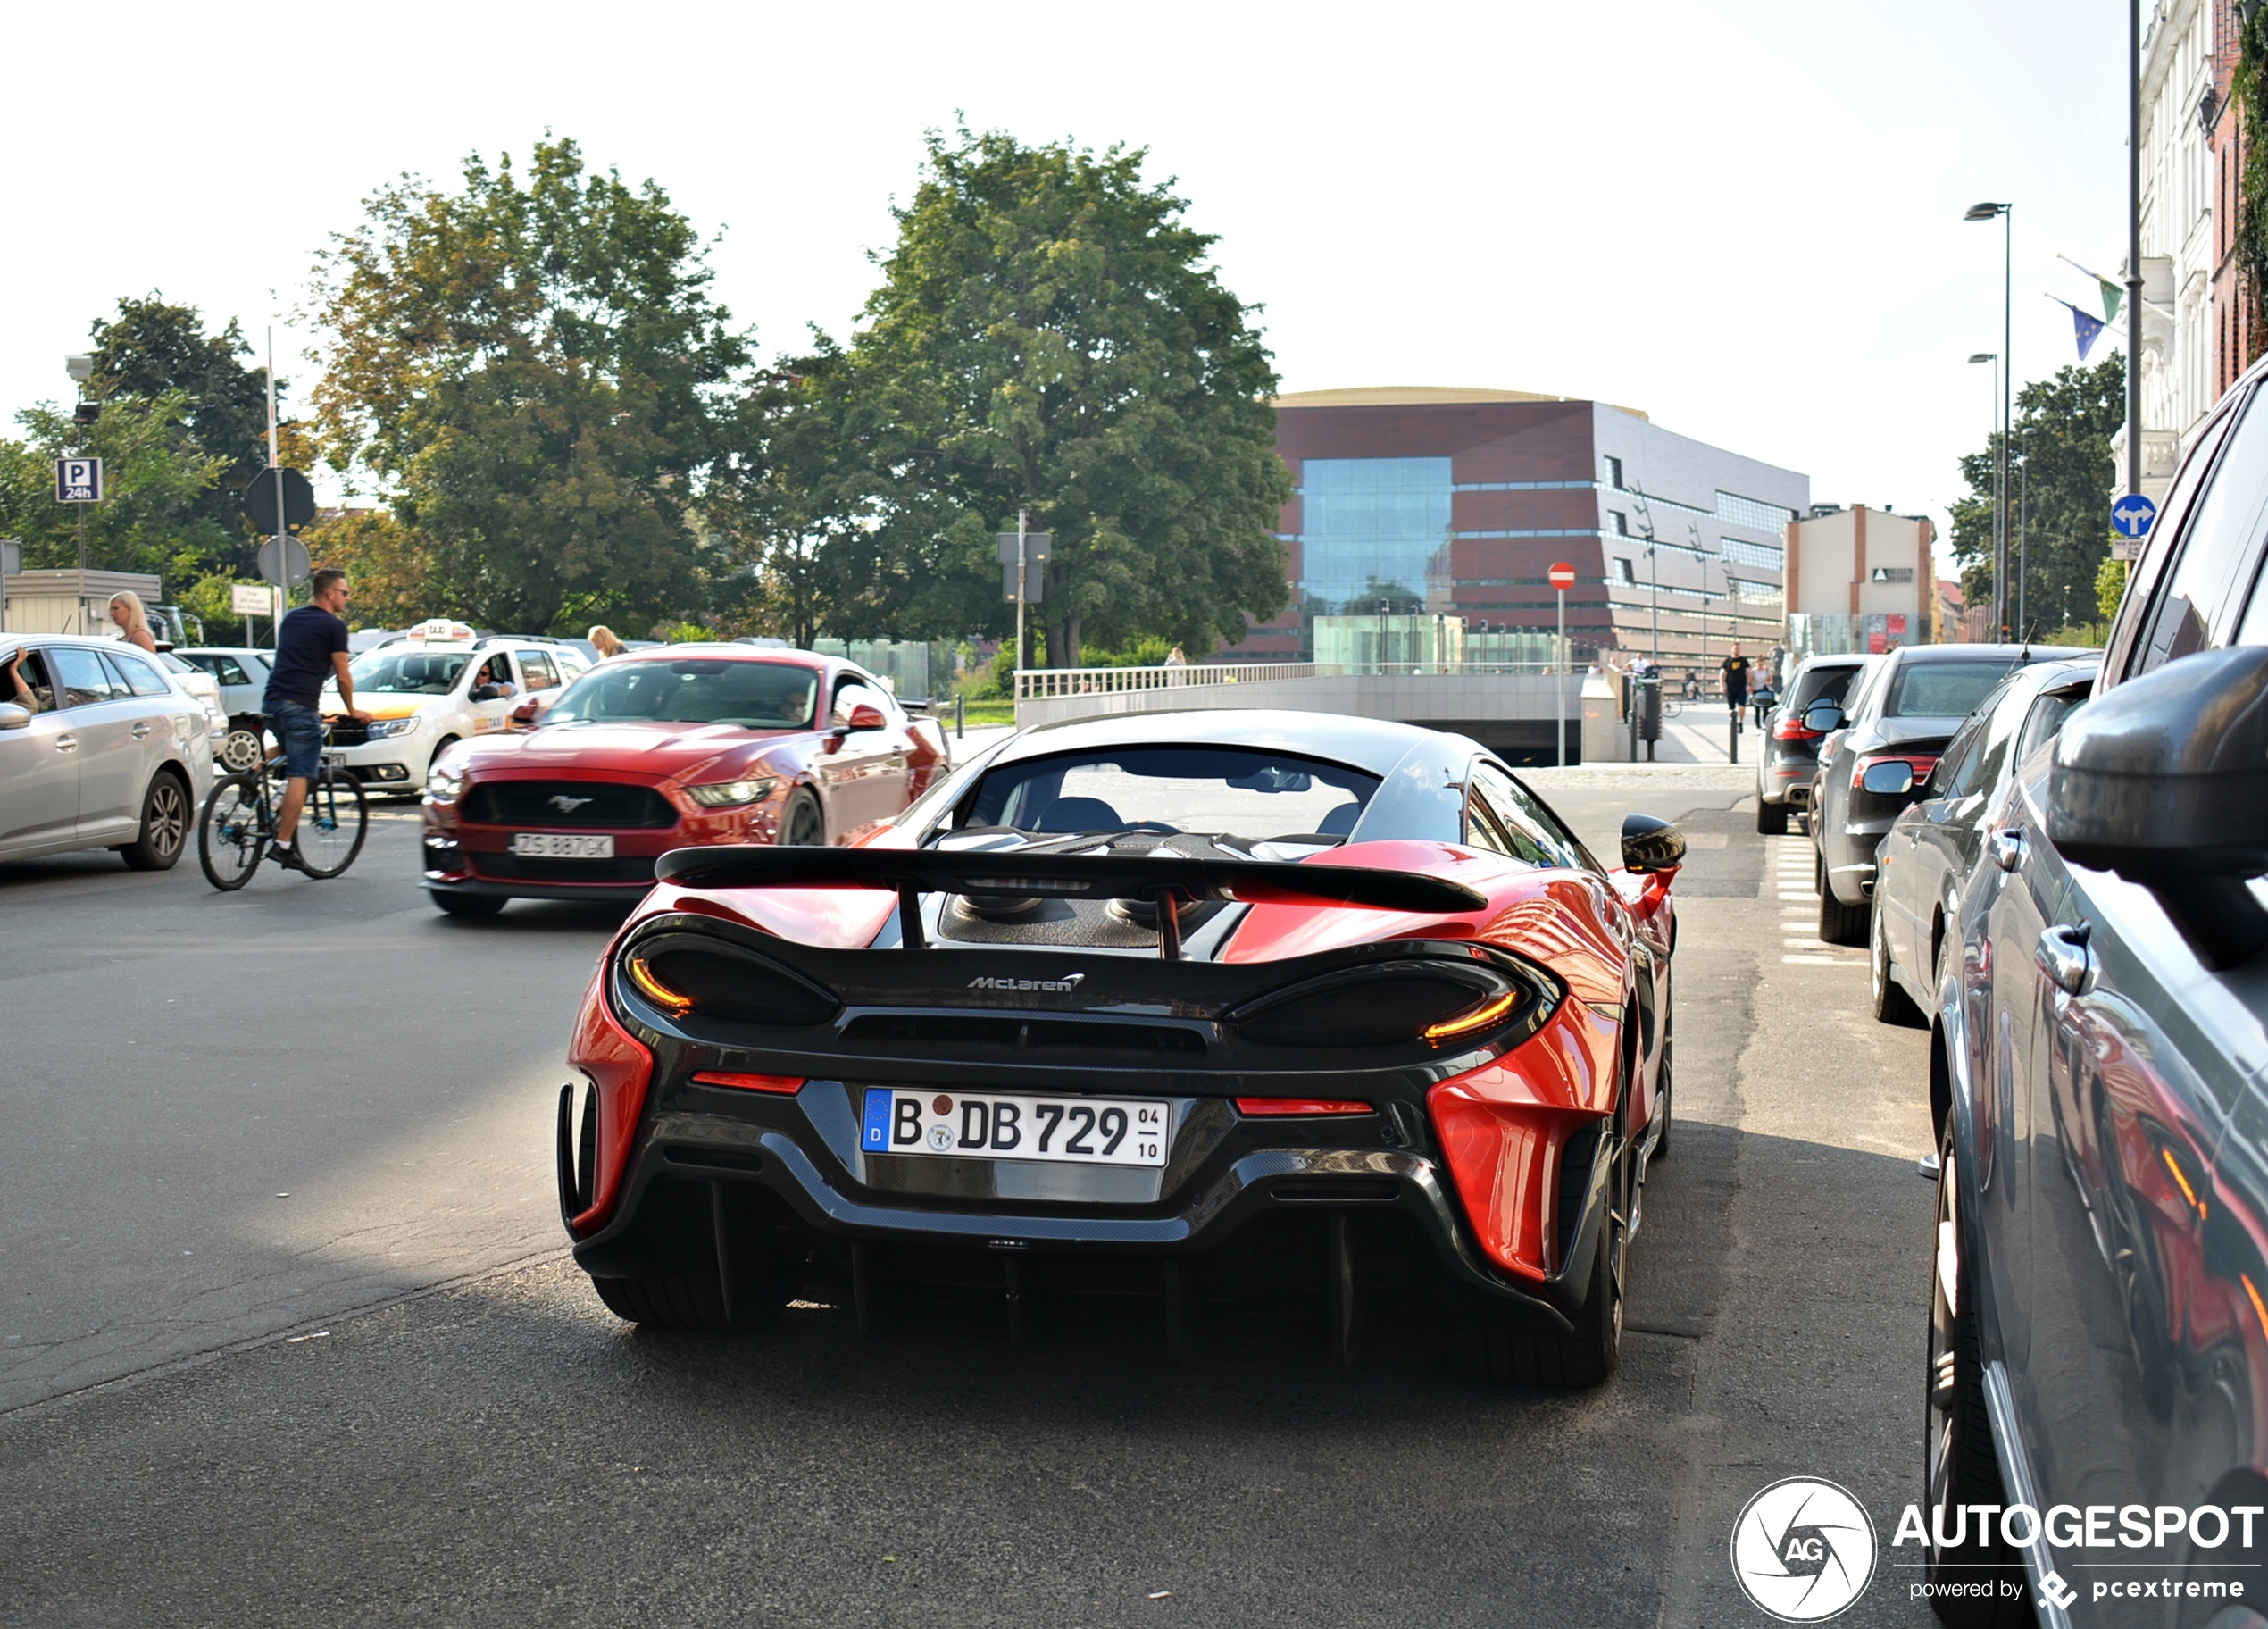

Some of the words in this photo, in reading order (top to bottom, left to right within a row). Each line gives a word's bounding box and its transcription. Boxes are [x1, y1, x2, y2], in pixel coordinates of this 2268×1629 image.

[71, 465, 85, 484] P
[65, 487, 92, 499] 24h
[488, 717, 503, 728] TAXI
[517, 836, 544, 855] ZS
[551, 838, 611, 856] 887GK
[967, 976, 1071, 992] McLaren
[1138, 1109, 1158, 1124] 04
[870, 1127, 881, 1142] D
[893, 1098, 922, 1145] B
[957, 1100, 1021, 1150] DB
[1035, 1104, 1128, 1156] 729
[1138, 1143, 1158, 1158] 10
